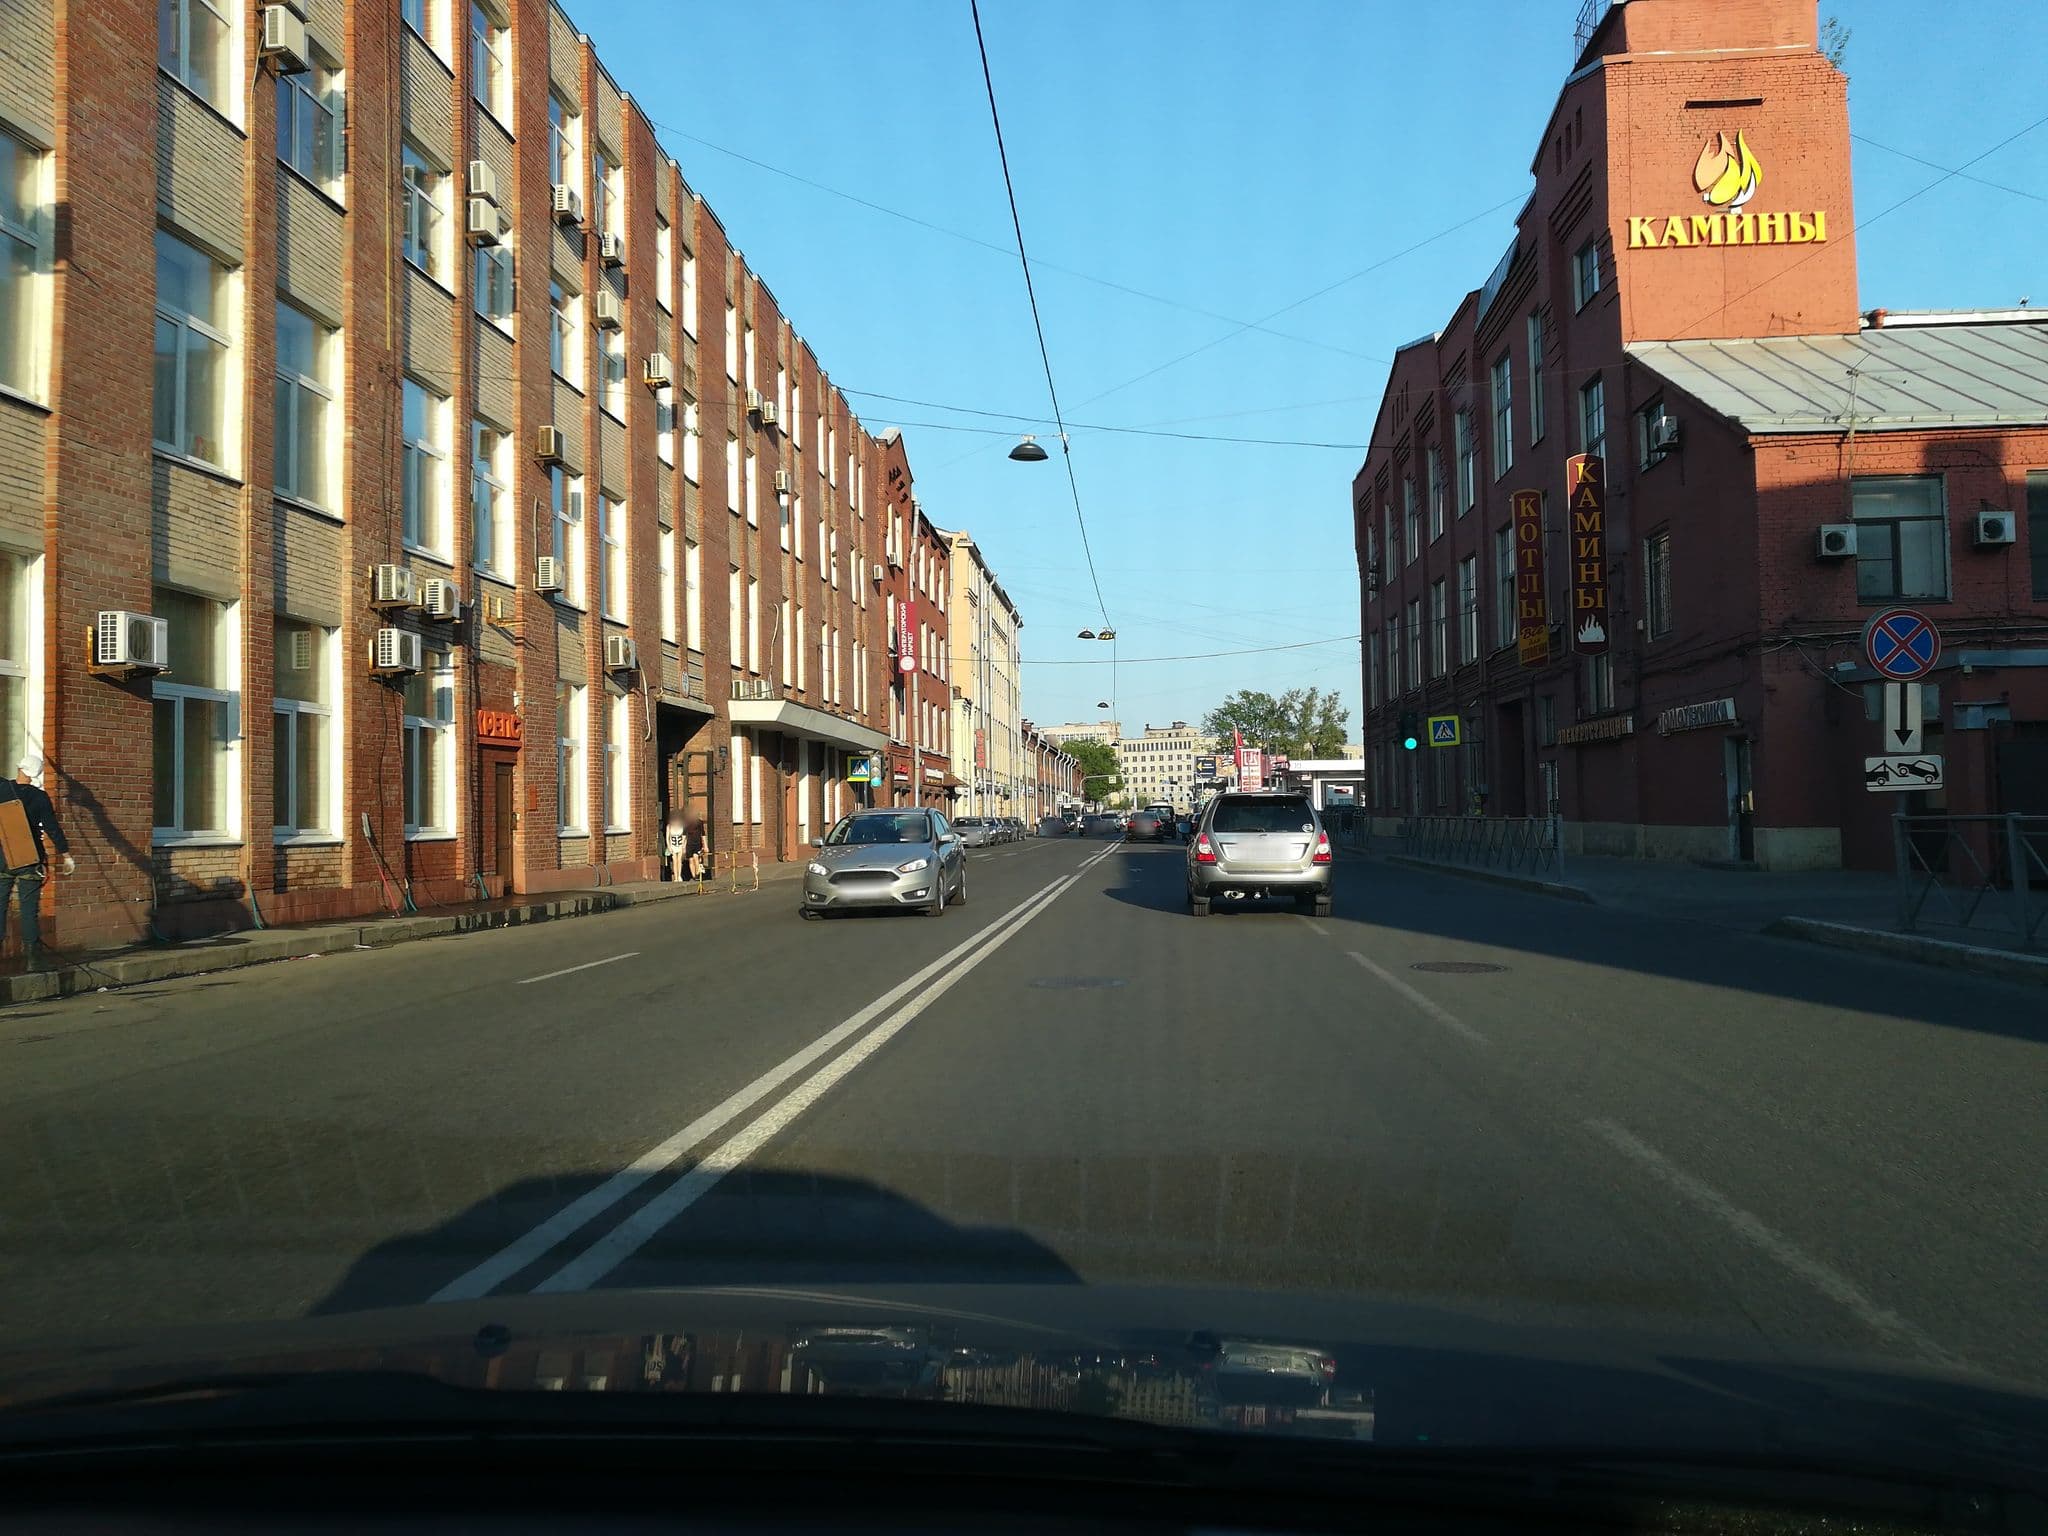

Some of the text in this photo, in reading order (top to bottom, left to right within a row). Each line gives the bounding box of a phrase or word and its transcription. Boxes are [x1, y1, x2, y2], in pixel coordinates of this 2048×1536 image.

[1627, 211, 1828, 249] КАМИНЫ
[1519, 498, 1545, 619] КОТЛЫ
[1574, 462, 1605, 609] КАМИНЫ
[671, 836, 683, 846] 92
